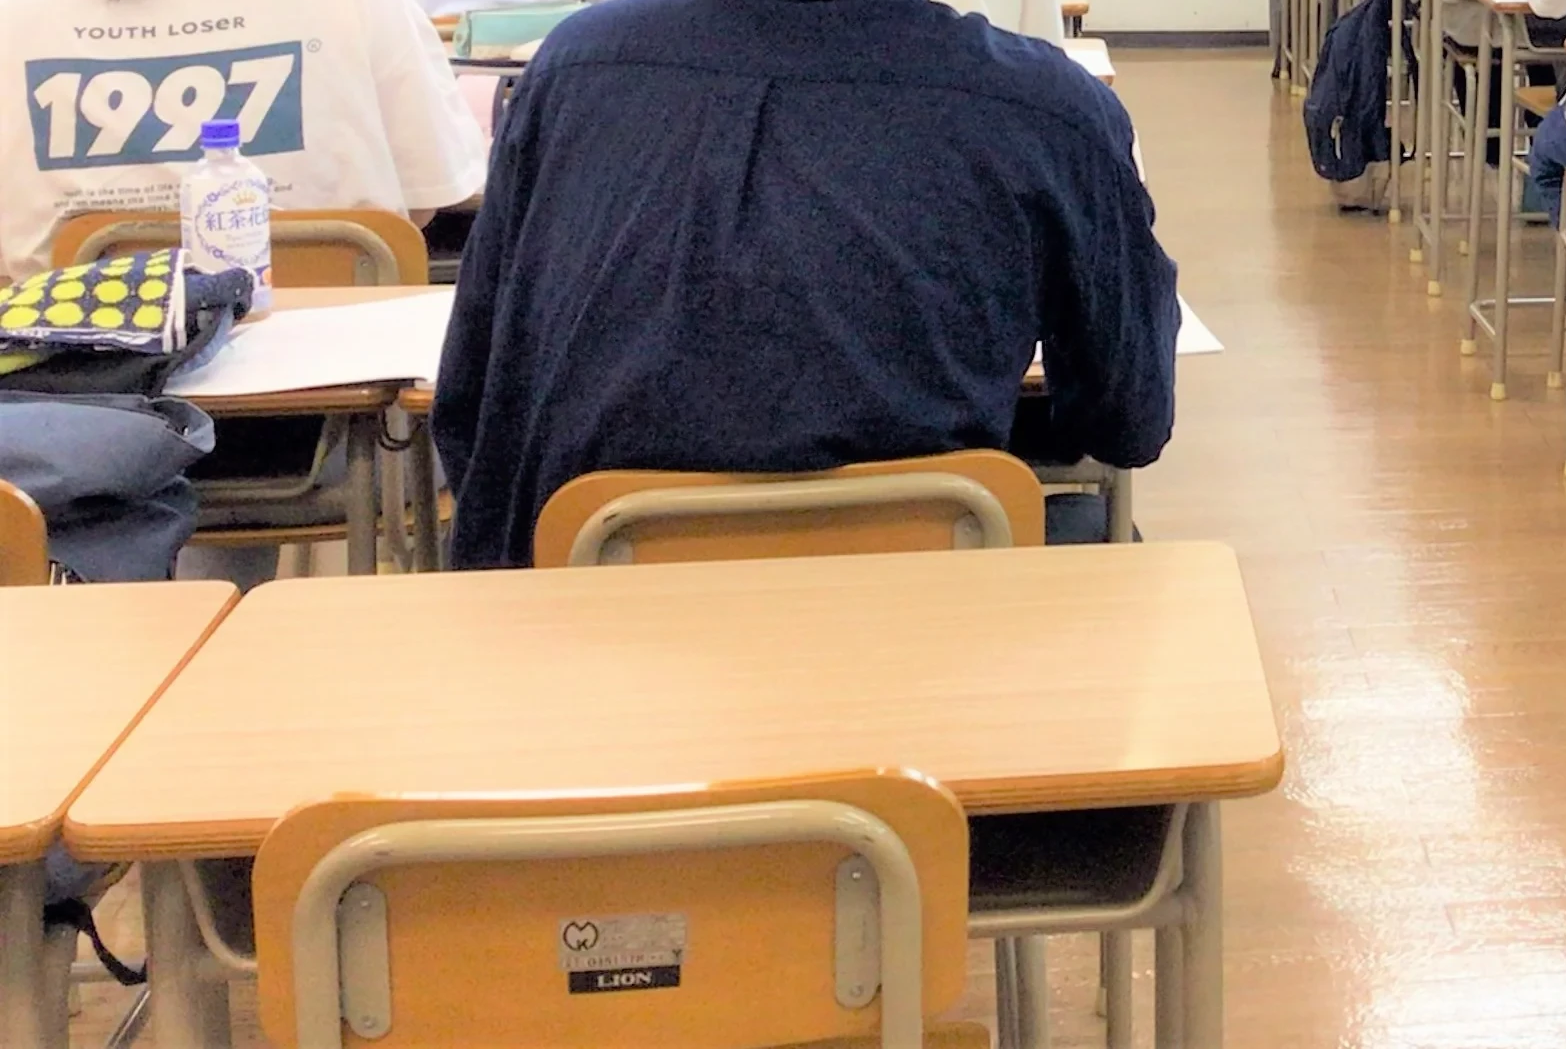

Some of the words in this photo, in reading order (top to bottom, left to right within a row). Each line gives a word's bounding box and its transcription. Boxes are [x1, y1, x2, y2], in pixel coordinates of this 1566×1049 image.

[73, 26, 157, 40] YOUTH
[33, 53, 295, 159] 1997
[205, 206, 269, 232] 紅茶花
[596, 971, 653, 988] LION
